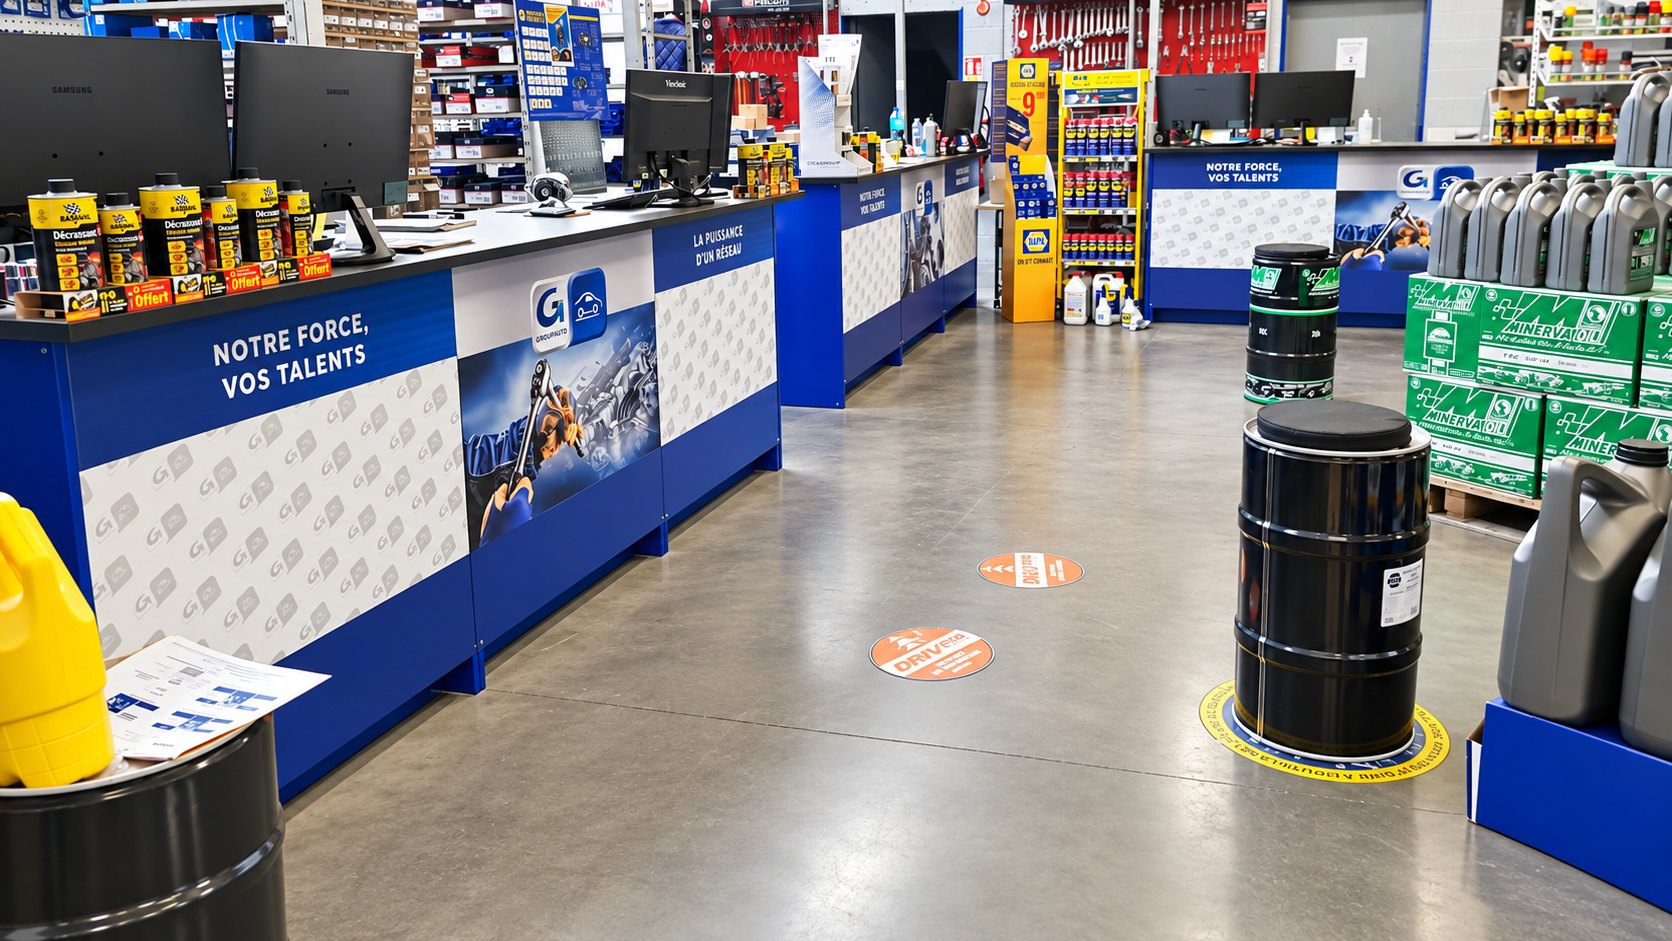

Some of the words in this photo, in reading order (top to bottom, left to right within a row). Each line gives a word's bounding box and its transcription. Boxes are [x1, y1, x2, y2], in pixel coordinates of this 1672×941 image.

[1023, 92, 1035, 117] 9
[1206, 162, 1242, 171] NOTRE
[1244, 162, 1282, 172] FORCE,
[1208, 174, 1230, 182] VOS
[1233, 174, 1279, 182] TALENTS
[693, 234, 704, 248] LA
[705, 224, 743, 245] PUISSANCE
[696, 250, 715, 267] D'UN
[716, 242, 742, 260] RÉSEAU
[304, 262, 329, 276] Offert
[231, 274, 260, 290] Offert
[135, 290, 169, 308] Offert
[213, 329, 291, 367] NOTRE
[297, 313, 369, 348] FORCE,
[222, 368, 270, 400] VOS
[276, 344, 366, 385] TALENTS
